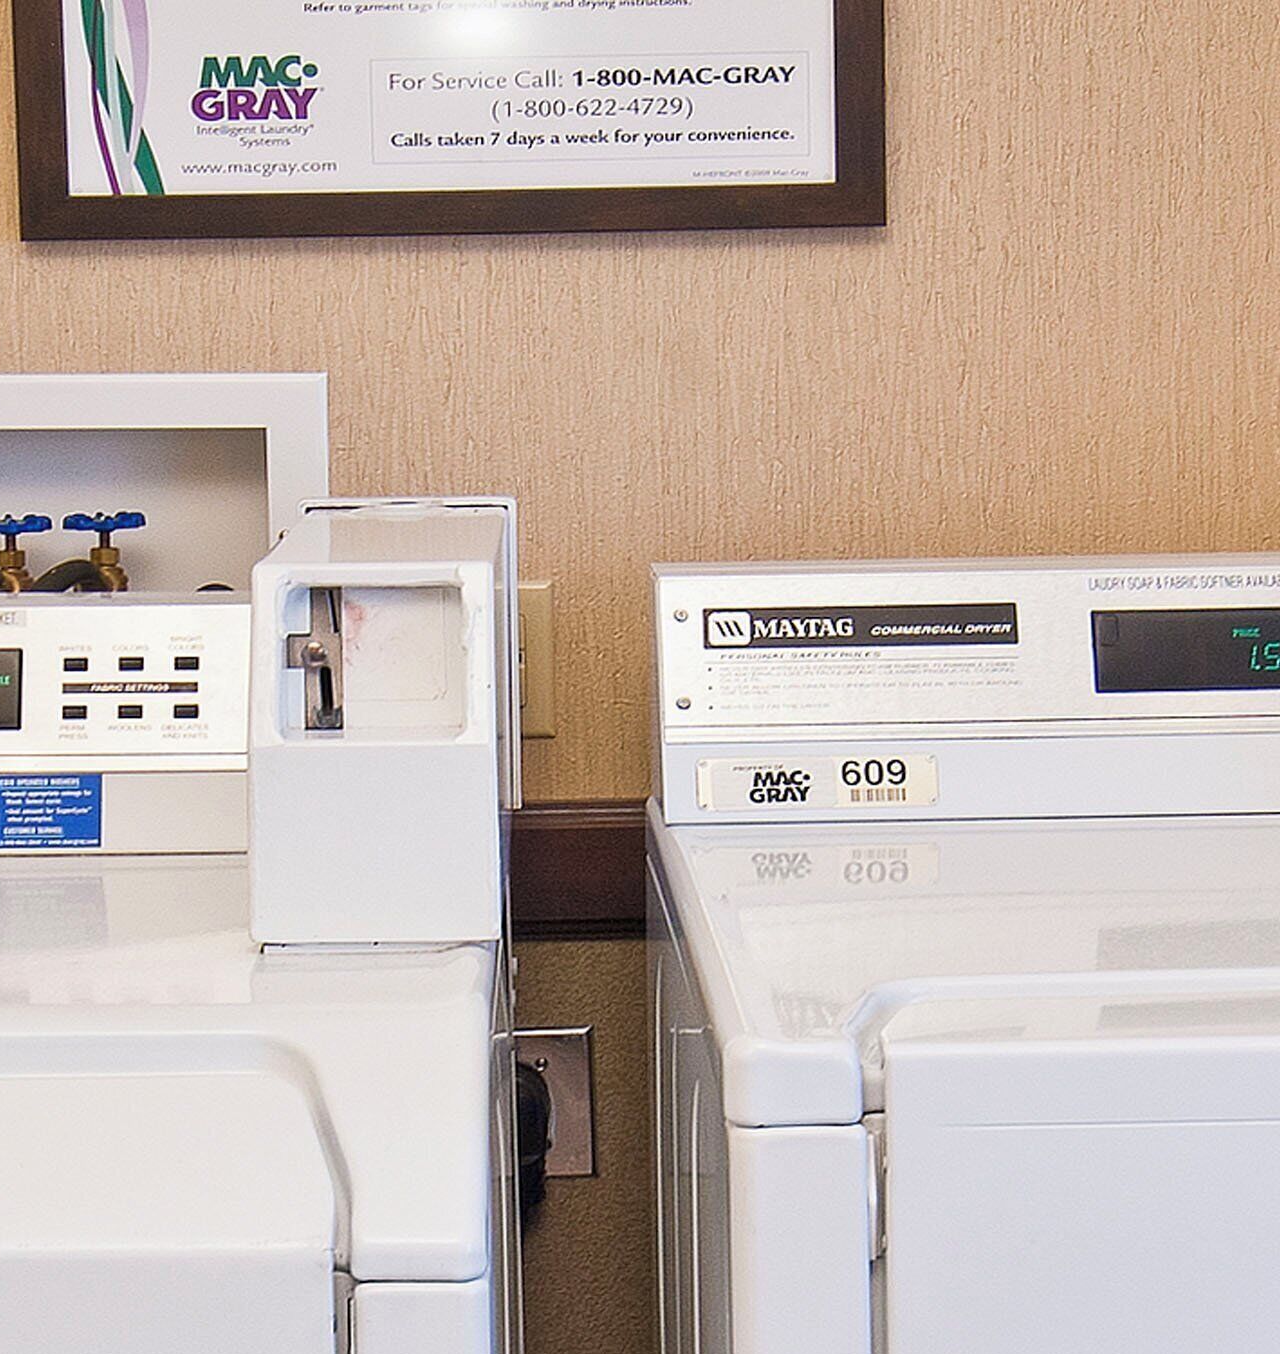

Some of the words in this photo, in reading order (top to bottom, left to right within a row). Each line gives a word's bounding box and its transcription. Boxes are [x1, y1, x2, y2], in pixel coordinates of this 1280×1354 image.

[303, 2, 335, 12] Refer
[338, 2, 352, 12] to
[355, 2, 405, 14] garment
[408, 1, 433, 13] tags
[437, 0, 456, 10] for
[553, 0, 574, 8] and
[578, 0, 616, 9] drying
[389, 73, 426, 91] For
[431, 71, 508, 90] Service
[514, 69, 564, 89] Call:
[571, 65, 796, 88] 1-800-MAC-GRAY
[191, 88, 319, 122] GRAY
[490, 97, 694, 124] (1-800-622-4729)
[195, 125, 257, 138] Intelligent
[390, 132, 433, 148] Calls
[437, 132, 485, 147] taken
[490, 132, 501, 146] 7
[506, 130, 546, 149] days
[549, 135, 561, 146] a
[564, 129, 609, 144] week
[613, 127, 641, 144] for
[644, 129, 683, 147] your
[687, 125, 796, 143] convenience.
[239, 137, 292, 149] Systems
[180, 160, 338, 177] www.macgray.com
[1126, 575, 1153, 590] SOAP
[1155, 576, 1162, 590] &
[1164, 575, 1198, 590] FABRIC
[1200, 574, 1243, 589] SOFTNER
[752, 618, 854, 639] MAYTAG
[870, 624, 963, 636] COMMERCIAL
[964, 623, 1012, 634] DRYER
[112, 644, 149, 652] COLORS
[168, 643, 205, 651] COLORS
[90, 684, 123, 692] FABRIC
[124, 683, 170, 692] SETTINGS
[160, 724, 209, 732] DELICATES
[58, 732, 89, 741] PRESS
[841, 759, 908, 787] 609
[749, 786, 811, 804] GRAY
